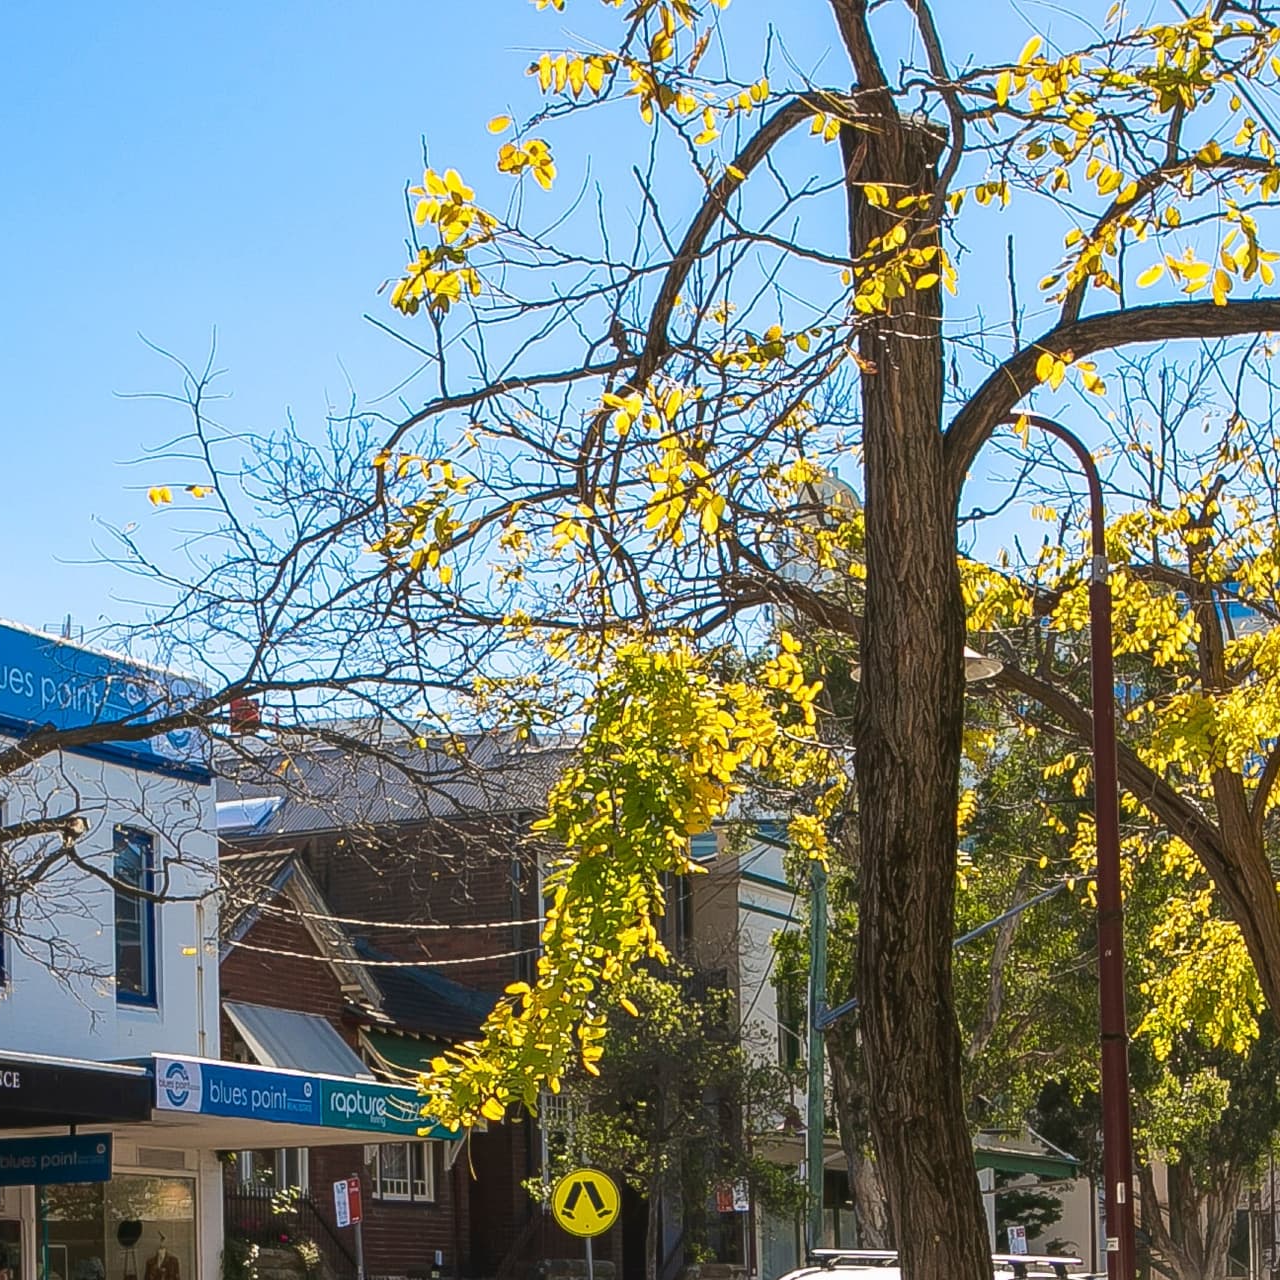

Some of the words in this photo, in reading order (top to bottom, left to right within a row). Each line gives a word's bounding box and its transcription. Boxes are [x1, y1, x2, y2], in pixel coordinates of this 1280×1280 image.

[41, 676, 102, 715] point
[209, 1080, 247, 1106] blues
[251, 1086, 287, 1112] point
[330, 1090, 386, 1118] rapture
[0, 1154, 37, 1169] blues
[41, 1151, 77, 1170] point
